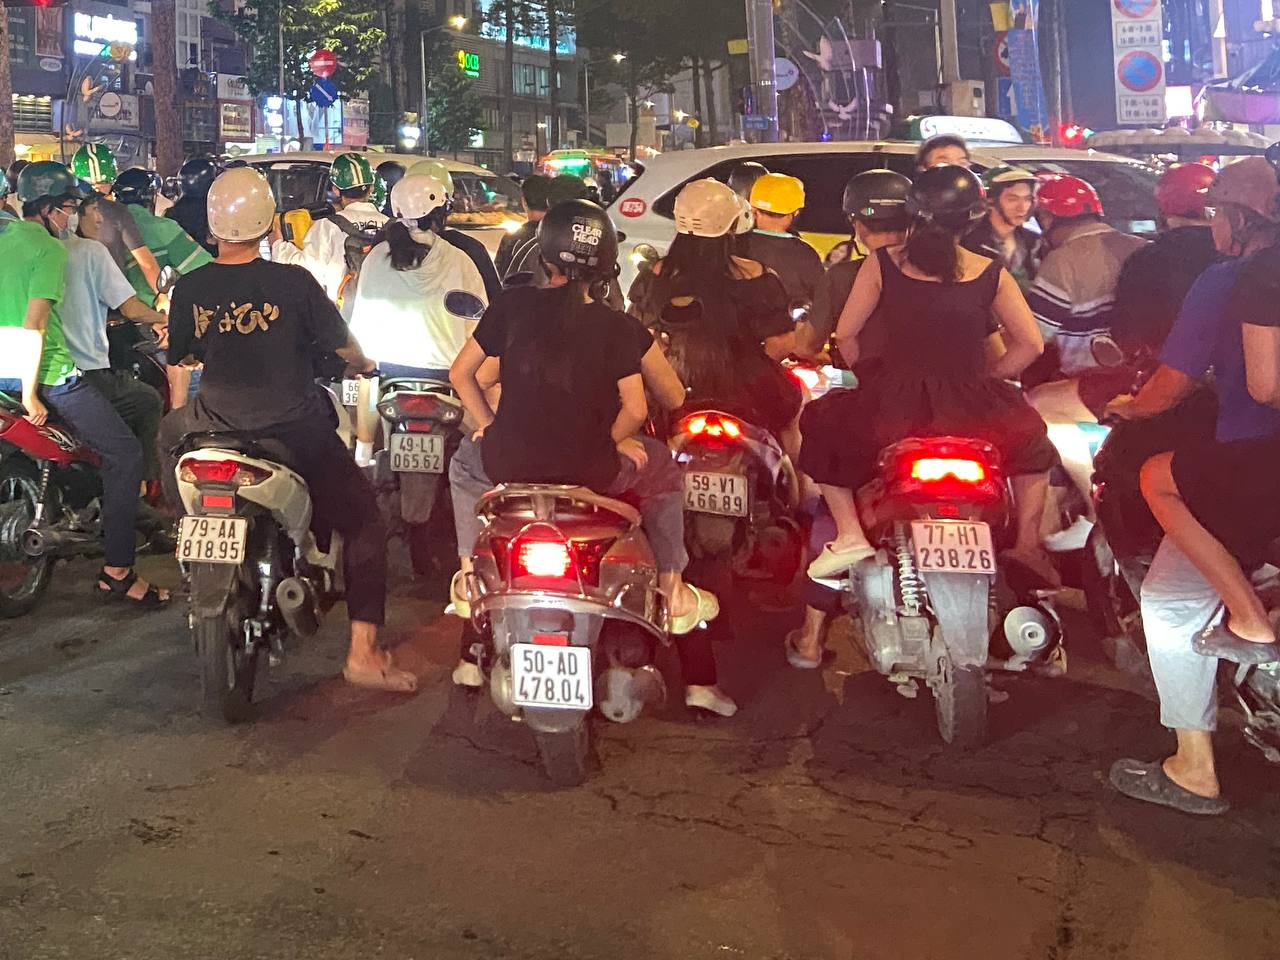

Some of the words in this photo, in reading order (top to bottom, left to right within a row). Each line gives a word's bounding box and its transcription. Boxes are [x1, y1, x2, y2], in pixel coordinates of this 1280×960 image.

[572, 223, 602, 238] CLEAR
[573, 231, 599, 245] HEAD
[399, 437, 435, 453] 49-L1
[393, 453, 440, 470] 065.62
[692, 475, 735, 494] 59-V1
[190, 519, 236, 538] 79-AA
[924, 524, 979, 546] 77-H1
[183, 539, 240, 560] 818.95
[920, 547, 992, 569] 238.26
[523, 649, 578, 676] 50-AD
[519, 676, 585, 704] 478.04
